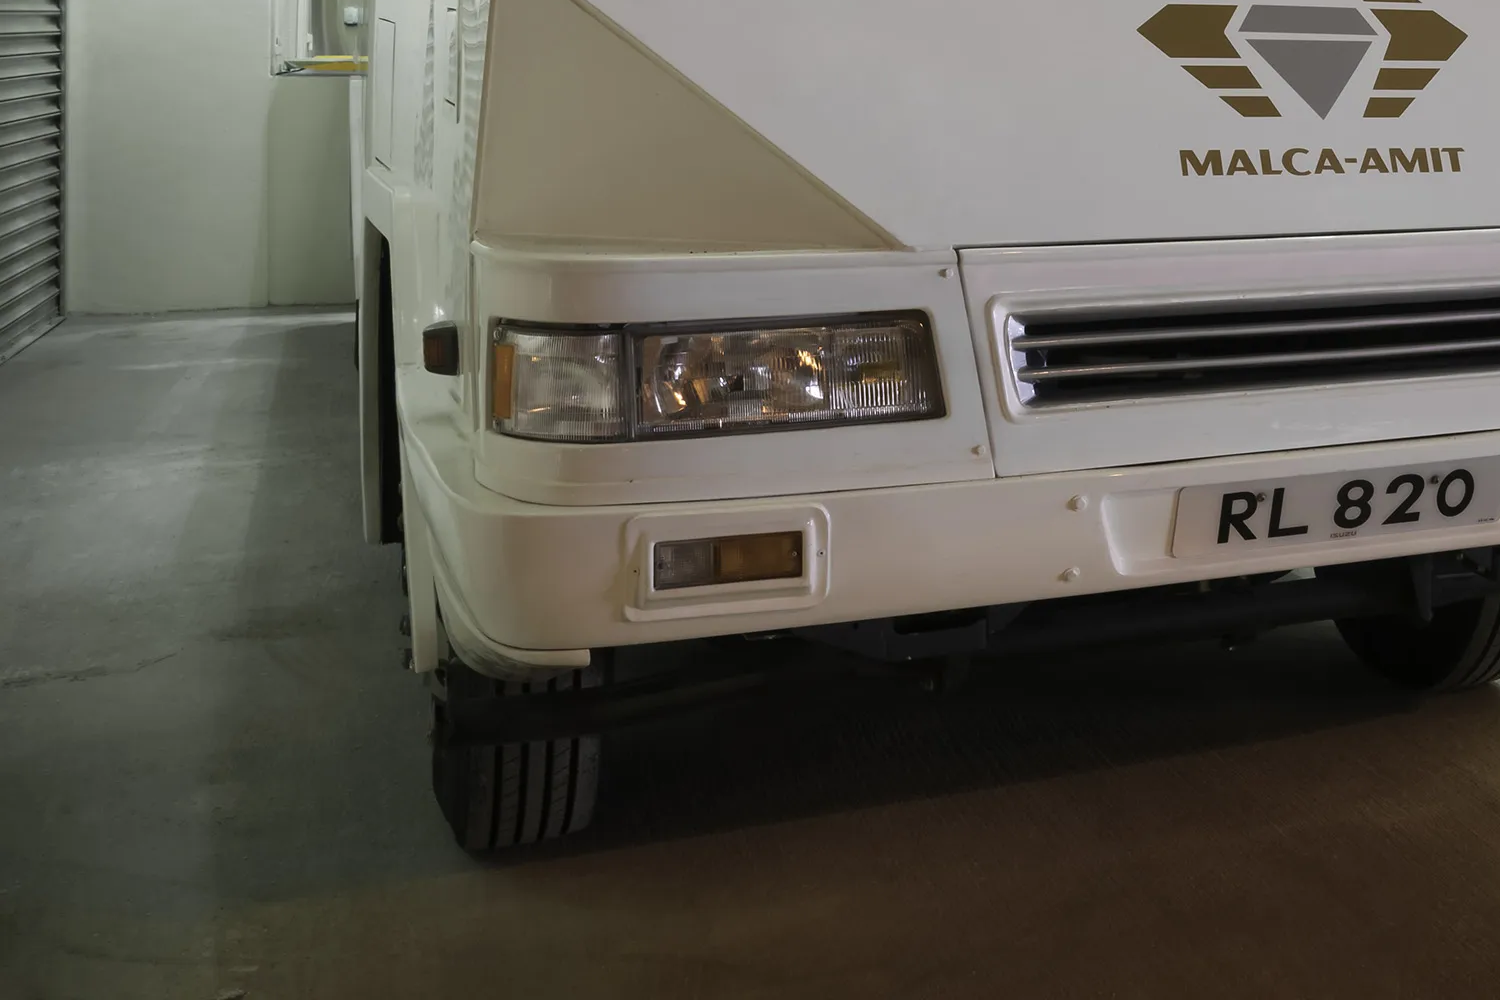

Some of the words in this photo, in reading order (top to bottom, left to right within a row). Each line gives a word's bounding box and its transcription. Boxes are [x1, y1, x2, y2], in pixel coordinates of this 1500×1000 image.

[1178, 147, 1465, 177] MALCA-AMIT
[1216, 487, 1309, 544] RL
[1333, 468, 1475, 529] 820
[1329, 530, 1357, 539] ISUZU
